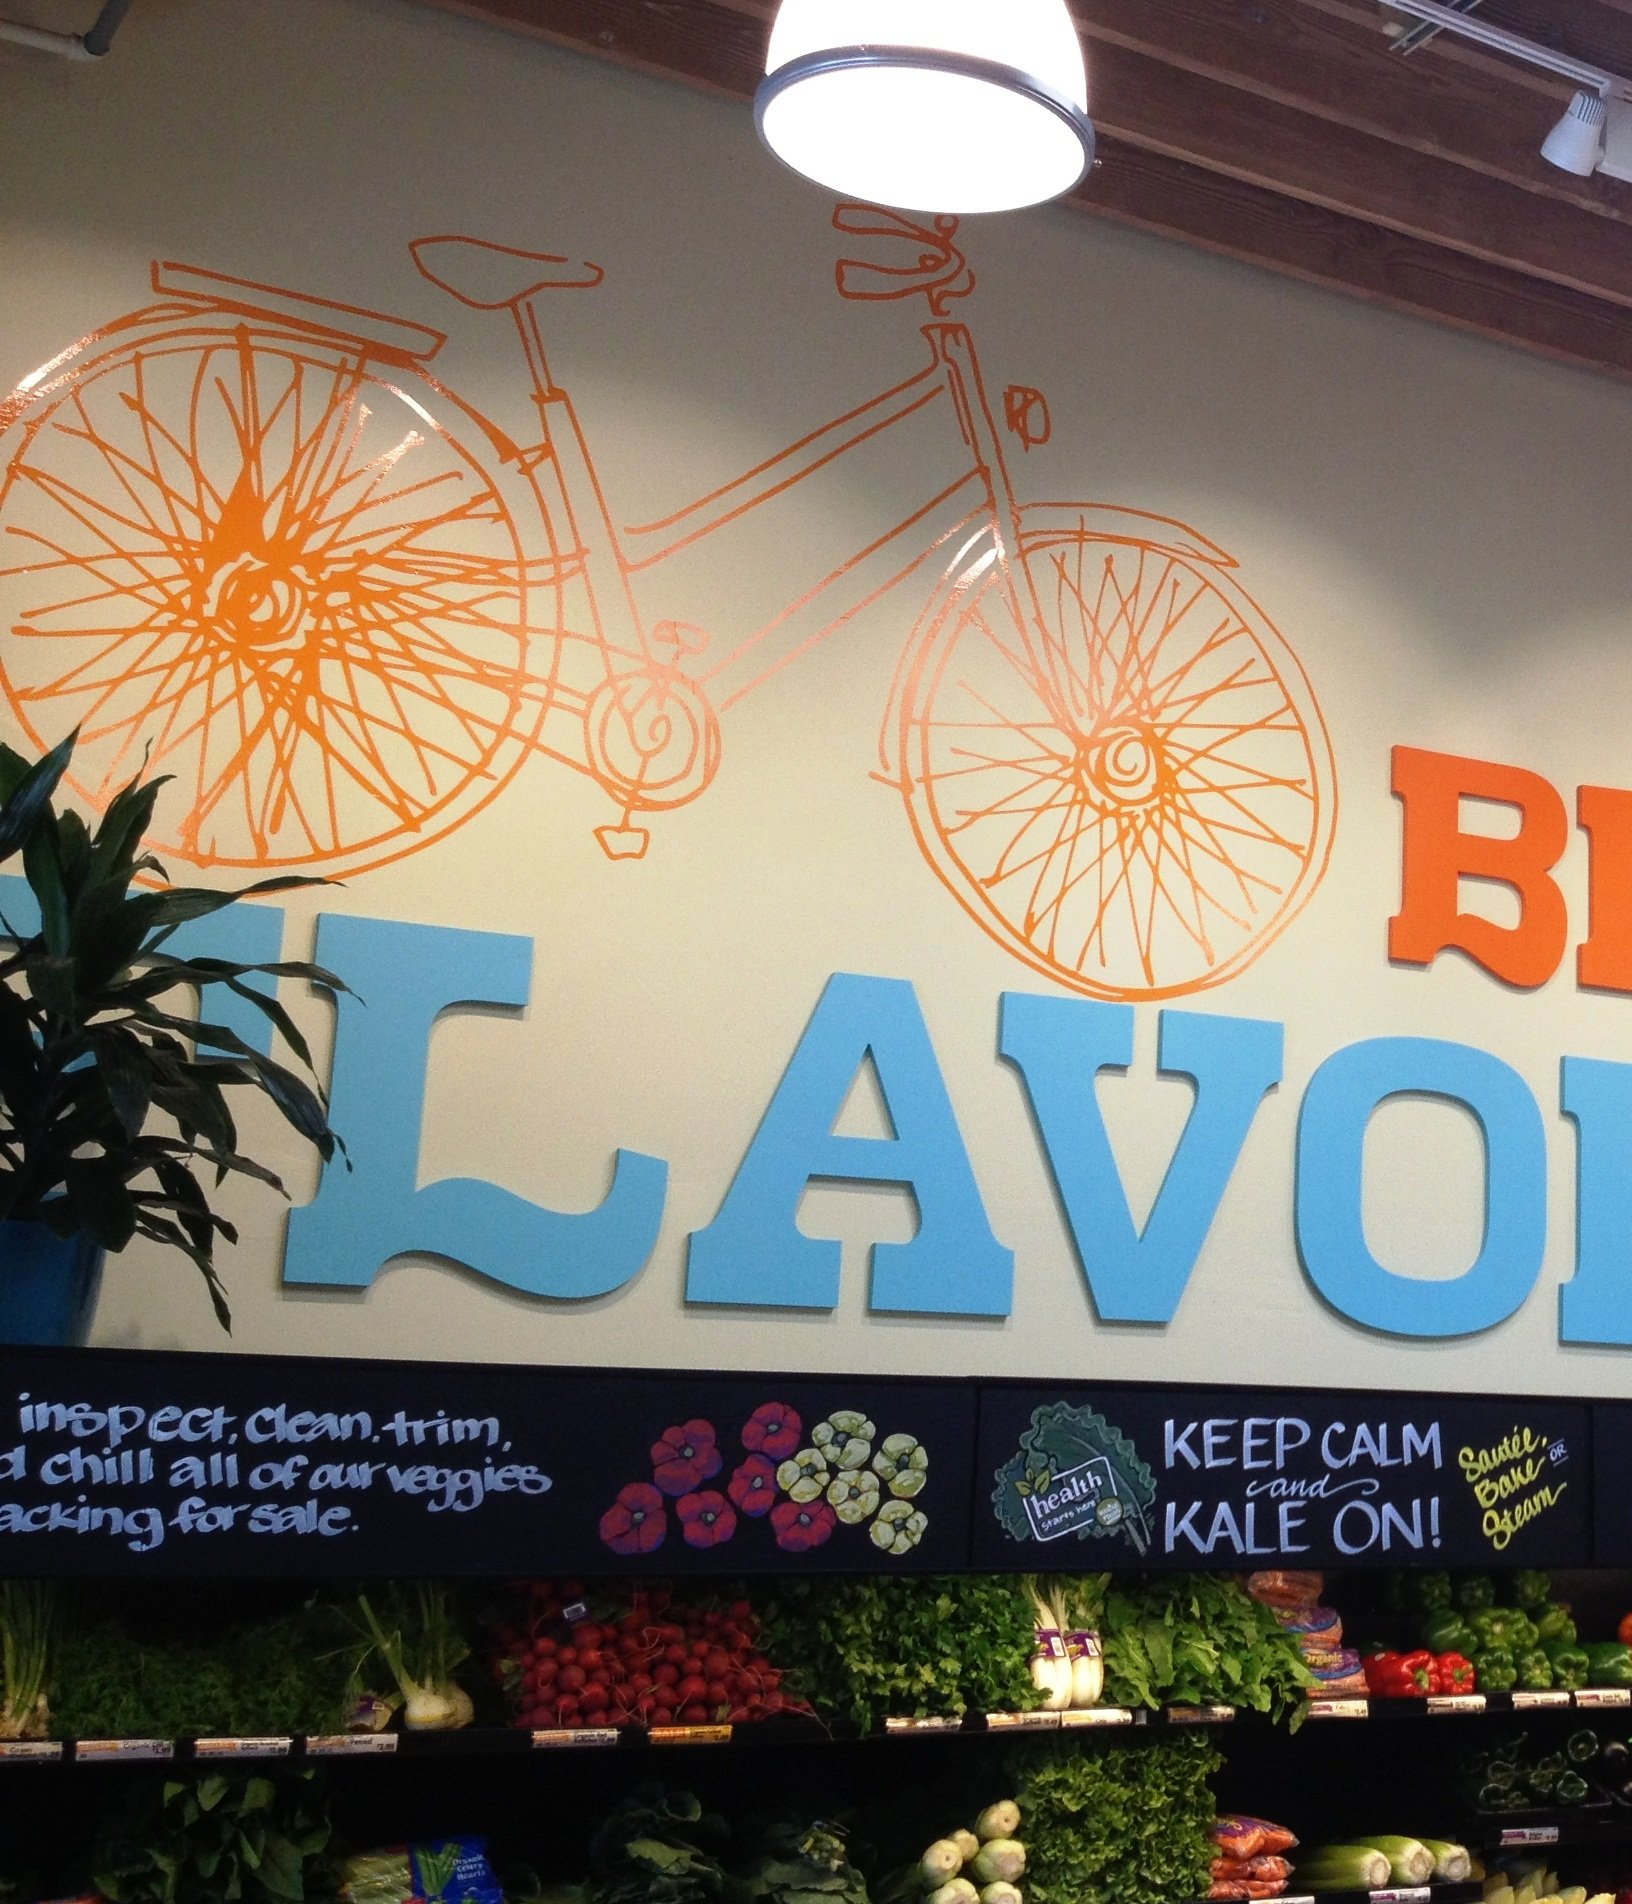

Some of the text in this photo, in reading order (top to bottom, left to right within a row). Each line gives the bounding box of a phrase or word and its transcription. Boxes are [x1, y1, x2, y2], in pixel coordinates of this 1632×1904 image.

[1164, 1417, 1442, 1470] KEEP CALM
[1550, 1443, 1567, 1461] OR
[40, 1446, 154, 1485] chill
[169, 1452, 239, 1489] all
[249, 1455, 309, 1490] of
[308, 1461, 387, 1490] our
[386, 1456, 553, 1512] veggies
[1030, 1470, 1103, 1519] health
[1260, 1473, 1379, 1499] and
[1474, 1456, 1545, 1508] Bake
[168, 1496, 251, 1534] for
[248, 1499, 360, 1537] sale.
[1164, 1500, 1311, 1555] KALE
[1333, 1497, 1441, 1555] ON!
[1483, 1482, 1567, 1550] Steam
